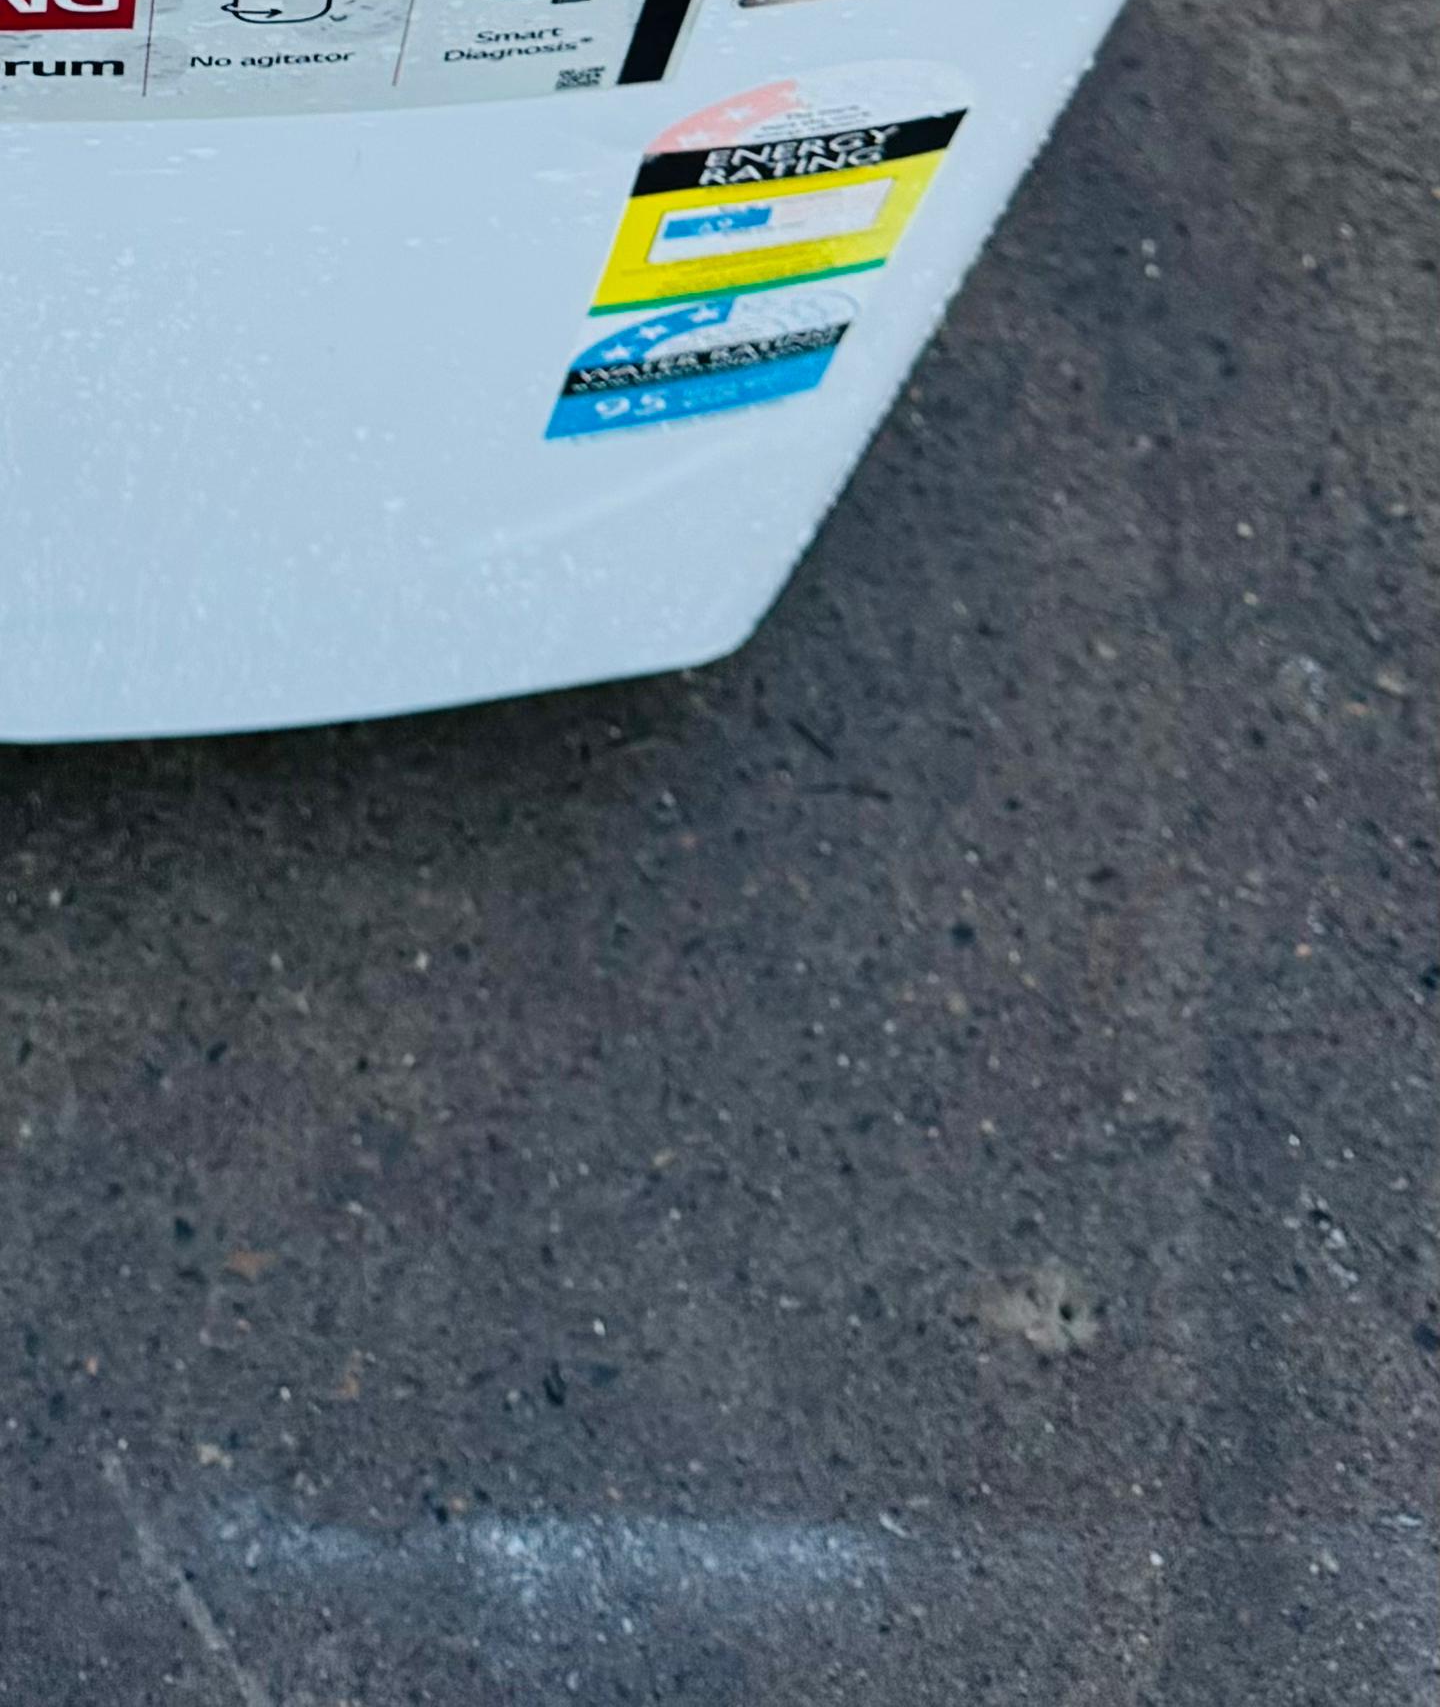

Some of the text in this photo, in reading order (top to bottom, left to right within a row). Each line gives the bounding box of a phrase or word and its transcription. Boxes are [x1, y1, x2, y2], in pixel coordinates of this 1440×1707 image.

[475, 27, 563, 44] Smart
[190, 51, 355, 68] No agitator
[705, 125, 900, 167] ENERGY
[699, 145, 885, 185] RATING
